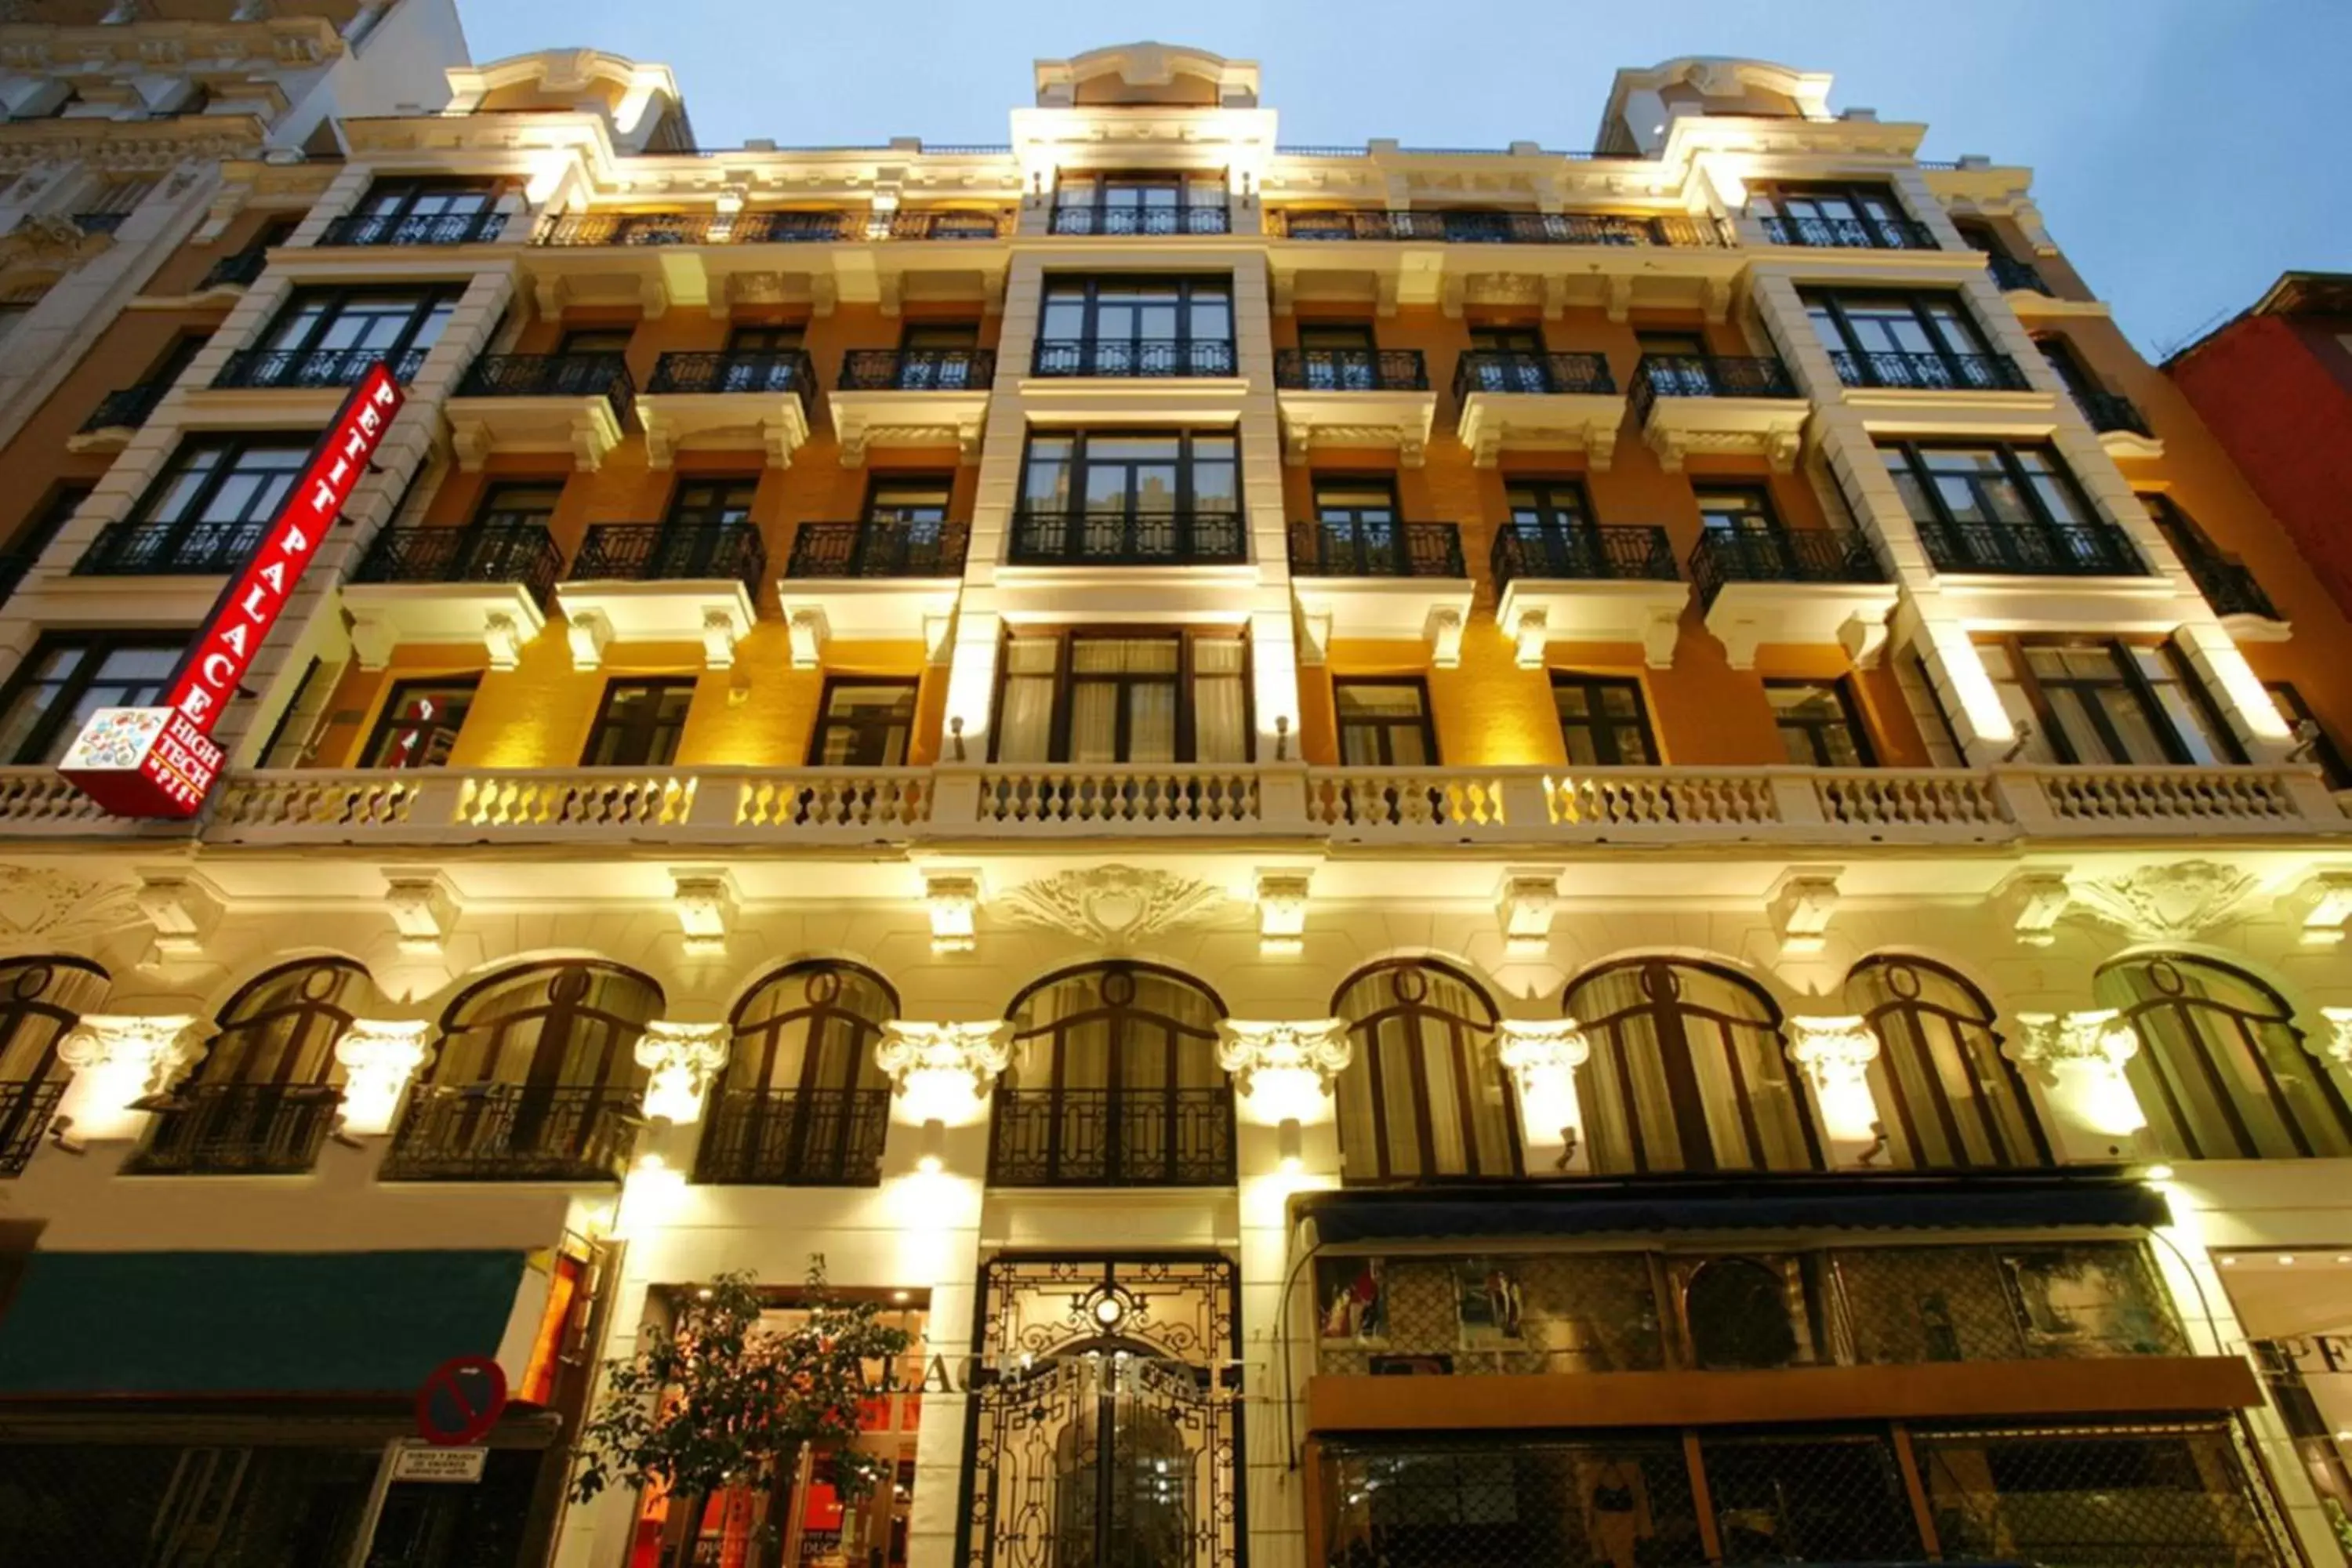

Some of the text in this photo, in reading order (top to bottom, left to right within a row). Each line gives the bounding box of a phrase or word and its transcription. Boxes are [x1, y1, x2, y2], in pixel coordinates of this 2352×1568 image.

[179, 379, 394, 724] PETIT PALACE
[159, 731, 212, 790] TECH
[169, 714, 223, 770] HIGH
